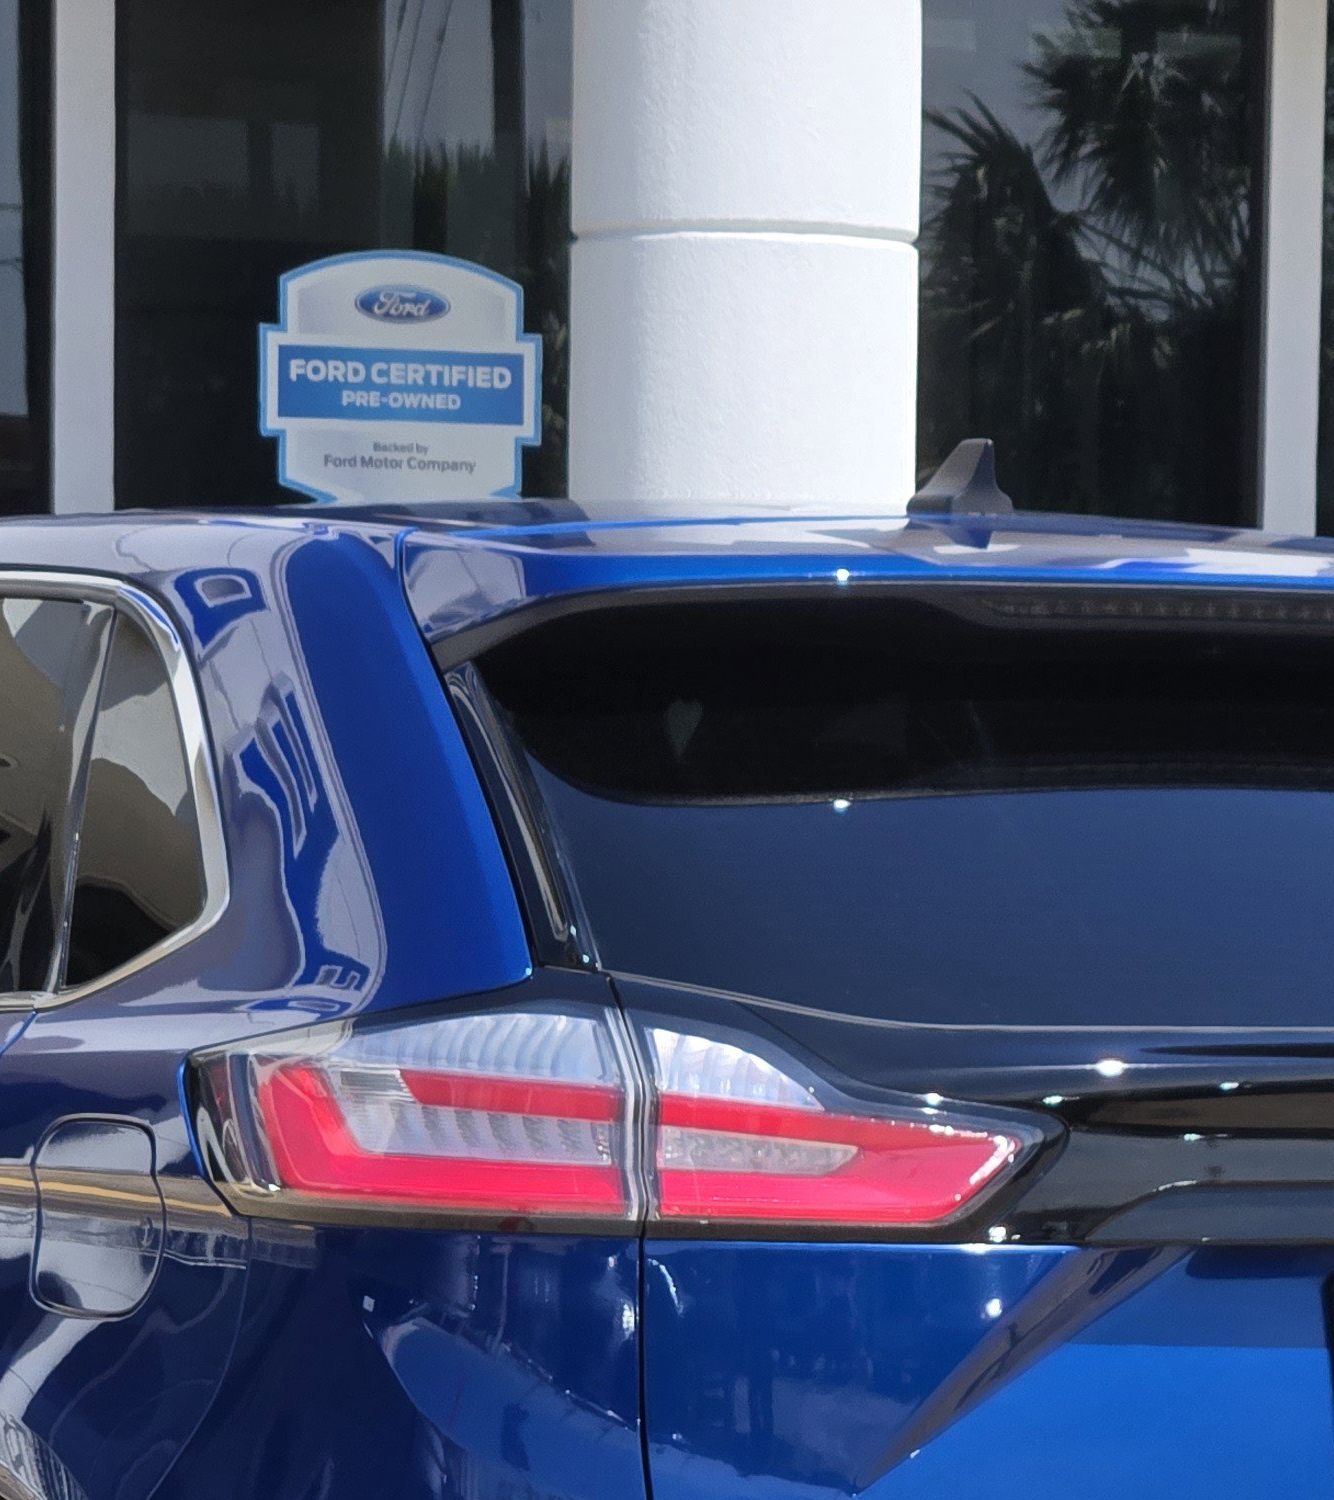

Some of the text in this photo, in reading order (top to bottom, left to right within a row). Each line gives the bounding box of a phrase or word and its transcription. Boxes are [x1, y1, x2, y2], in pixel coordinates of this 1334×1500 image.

[373, 290, 431, 317] Ford
[288, 359, 512, 389] FORD CERTIFIED
[341, 390, 461, 410] PRE-OWNED
[416, 443, 429, 455] by
[323, 454, 476, 474] Ford Motor Company
